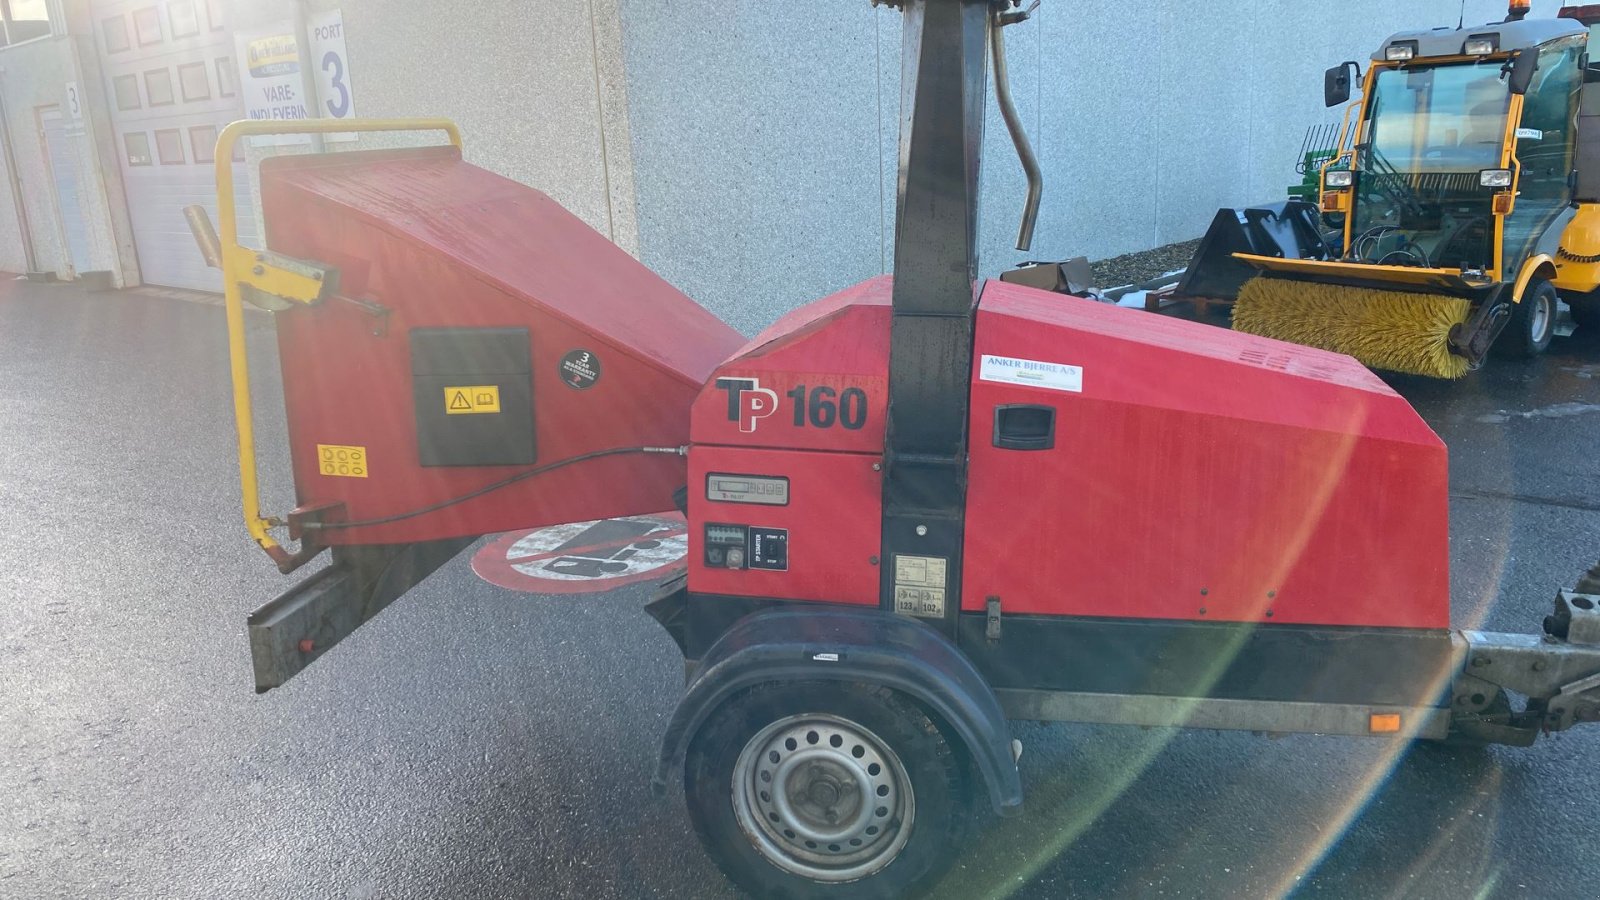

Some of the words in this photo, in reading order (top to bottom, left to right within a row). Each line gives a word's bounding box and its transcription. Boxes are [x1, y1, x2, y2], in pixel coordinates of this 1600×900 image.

[314, 23, 341, 40] PORT
[262, 84, 296, 102] VARE-
[321, 51, 349, 118] 3
[69, 87, 78, 113] 3
[575, 359, 590, 369] YEAR
[580, 352, 590, 363] 3
[565, 360, 597, 377] WARRANTY
[987, 357, 1021, 368] ANKER
[1023, 362, 1057, 373] BJERRE
[1060, 367, 1076, 376] A/S
[715, 376, 779, 433] TP
[786, 384, 868, 430] 160
[899, 601, 913, 610] 123
[923, 603, 936, 612] 102
